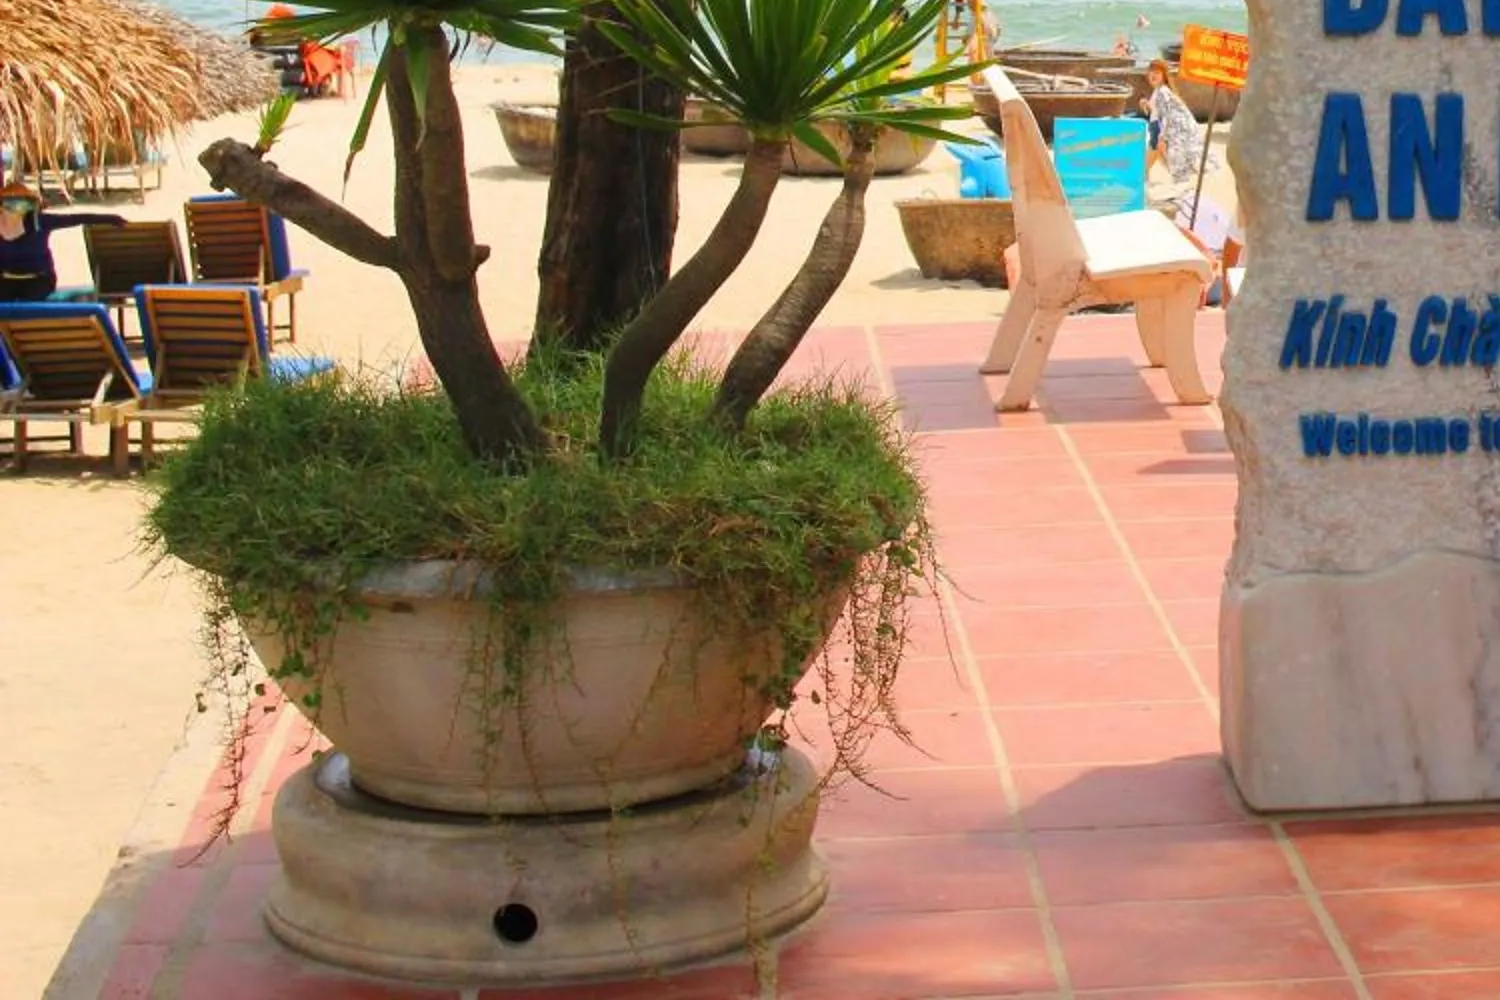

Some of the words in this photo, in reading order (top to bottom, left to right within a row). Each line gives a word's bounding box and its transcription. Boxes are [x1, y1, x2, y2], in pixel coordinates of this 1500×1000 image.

[1305, 91, 1464, 222] AN
[1278, 293, 1397, 371] Kính
[1299, 410, 1470, 457] Welcome
